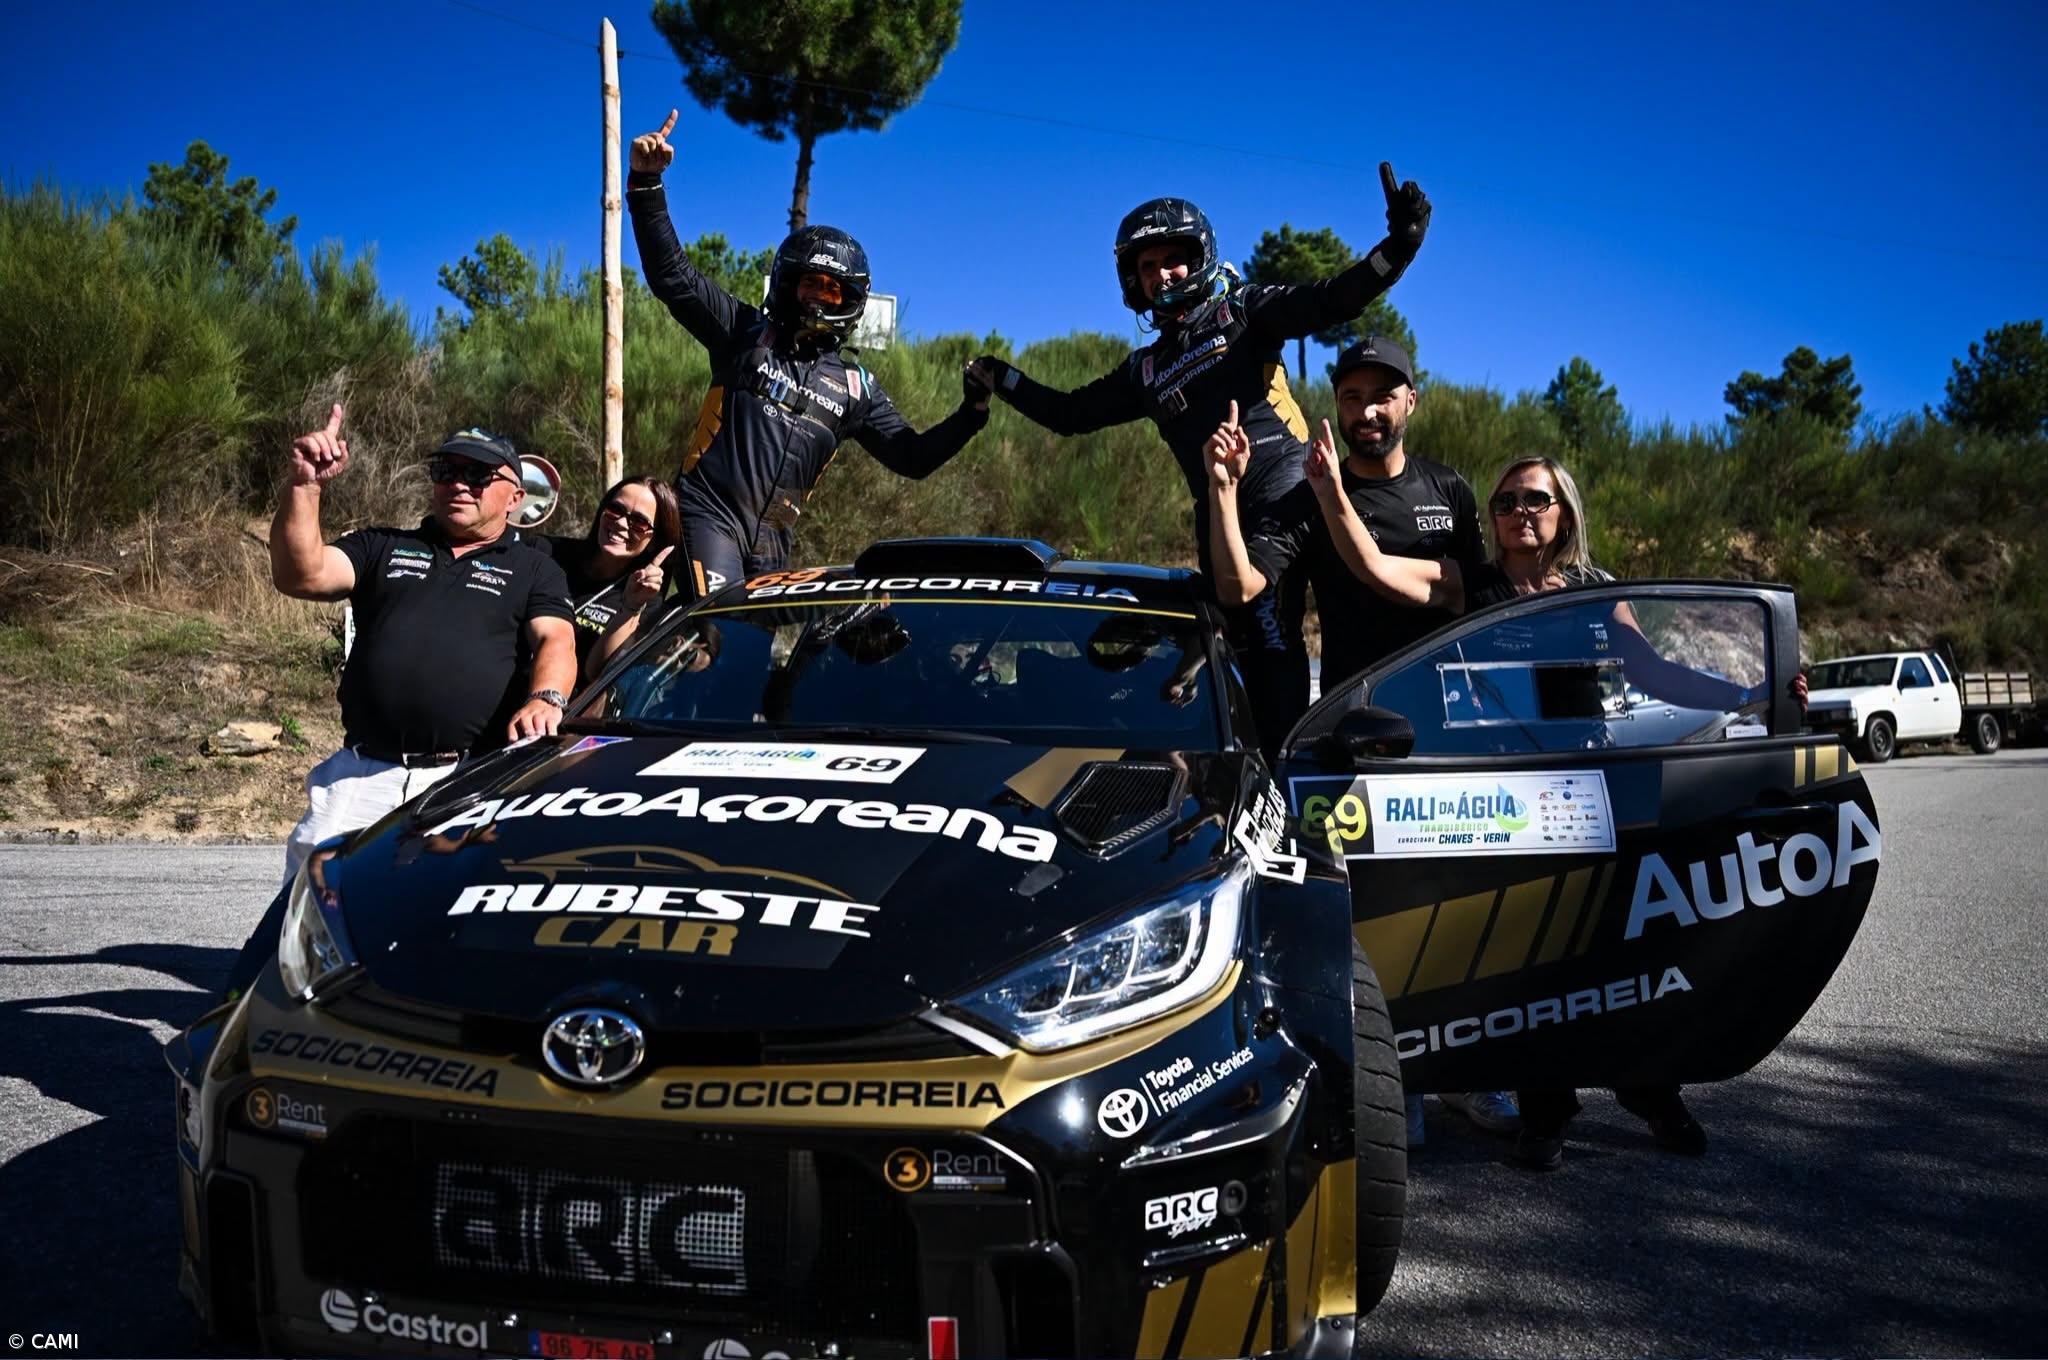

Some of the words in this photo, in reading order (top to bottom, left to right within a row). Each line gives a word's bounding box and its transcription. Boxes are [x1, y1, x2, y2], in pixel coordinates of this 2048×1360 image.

[745, 568, 827, 589] 69
[748, 578, 1140, 602] SOCICORREIA
[825, 756, 902, 773] 69
[1386, 797, 1436, 822] RALI
[1440, 801, 1455, 815] DA
[1456, 791, 1517, 820] ÁGUA
[424, 787, 1058, 863] AutoAçoreana
[1439, 833, 1474, 845] CHAVES
[447, 884, 880, 938] RUBESTE
[533, 916, 739, 956] CAR
[252, 1029, 499, 1098] SOCICORREIA
[1146, 1057, 1194, 1089] Toyota
[1158, 1067, 1216, 1113] Financial
[1212, 1046, 1254, 1080] Services
[277, 1092, 327, 1124] Rent
[661, 1081, 1005, 1110] SOCICORREIA
[933, 1150, 1006, 1174] Rent
[363, 1304, 488, 1349] Castrol
